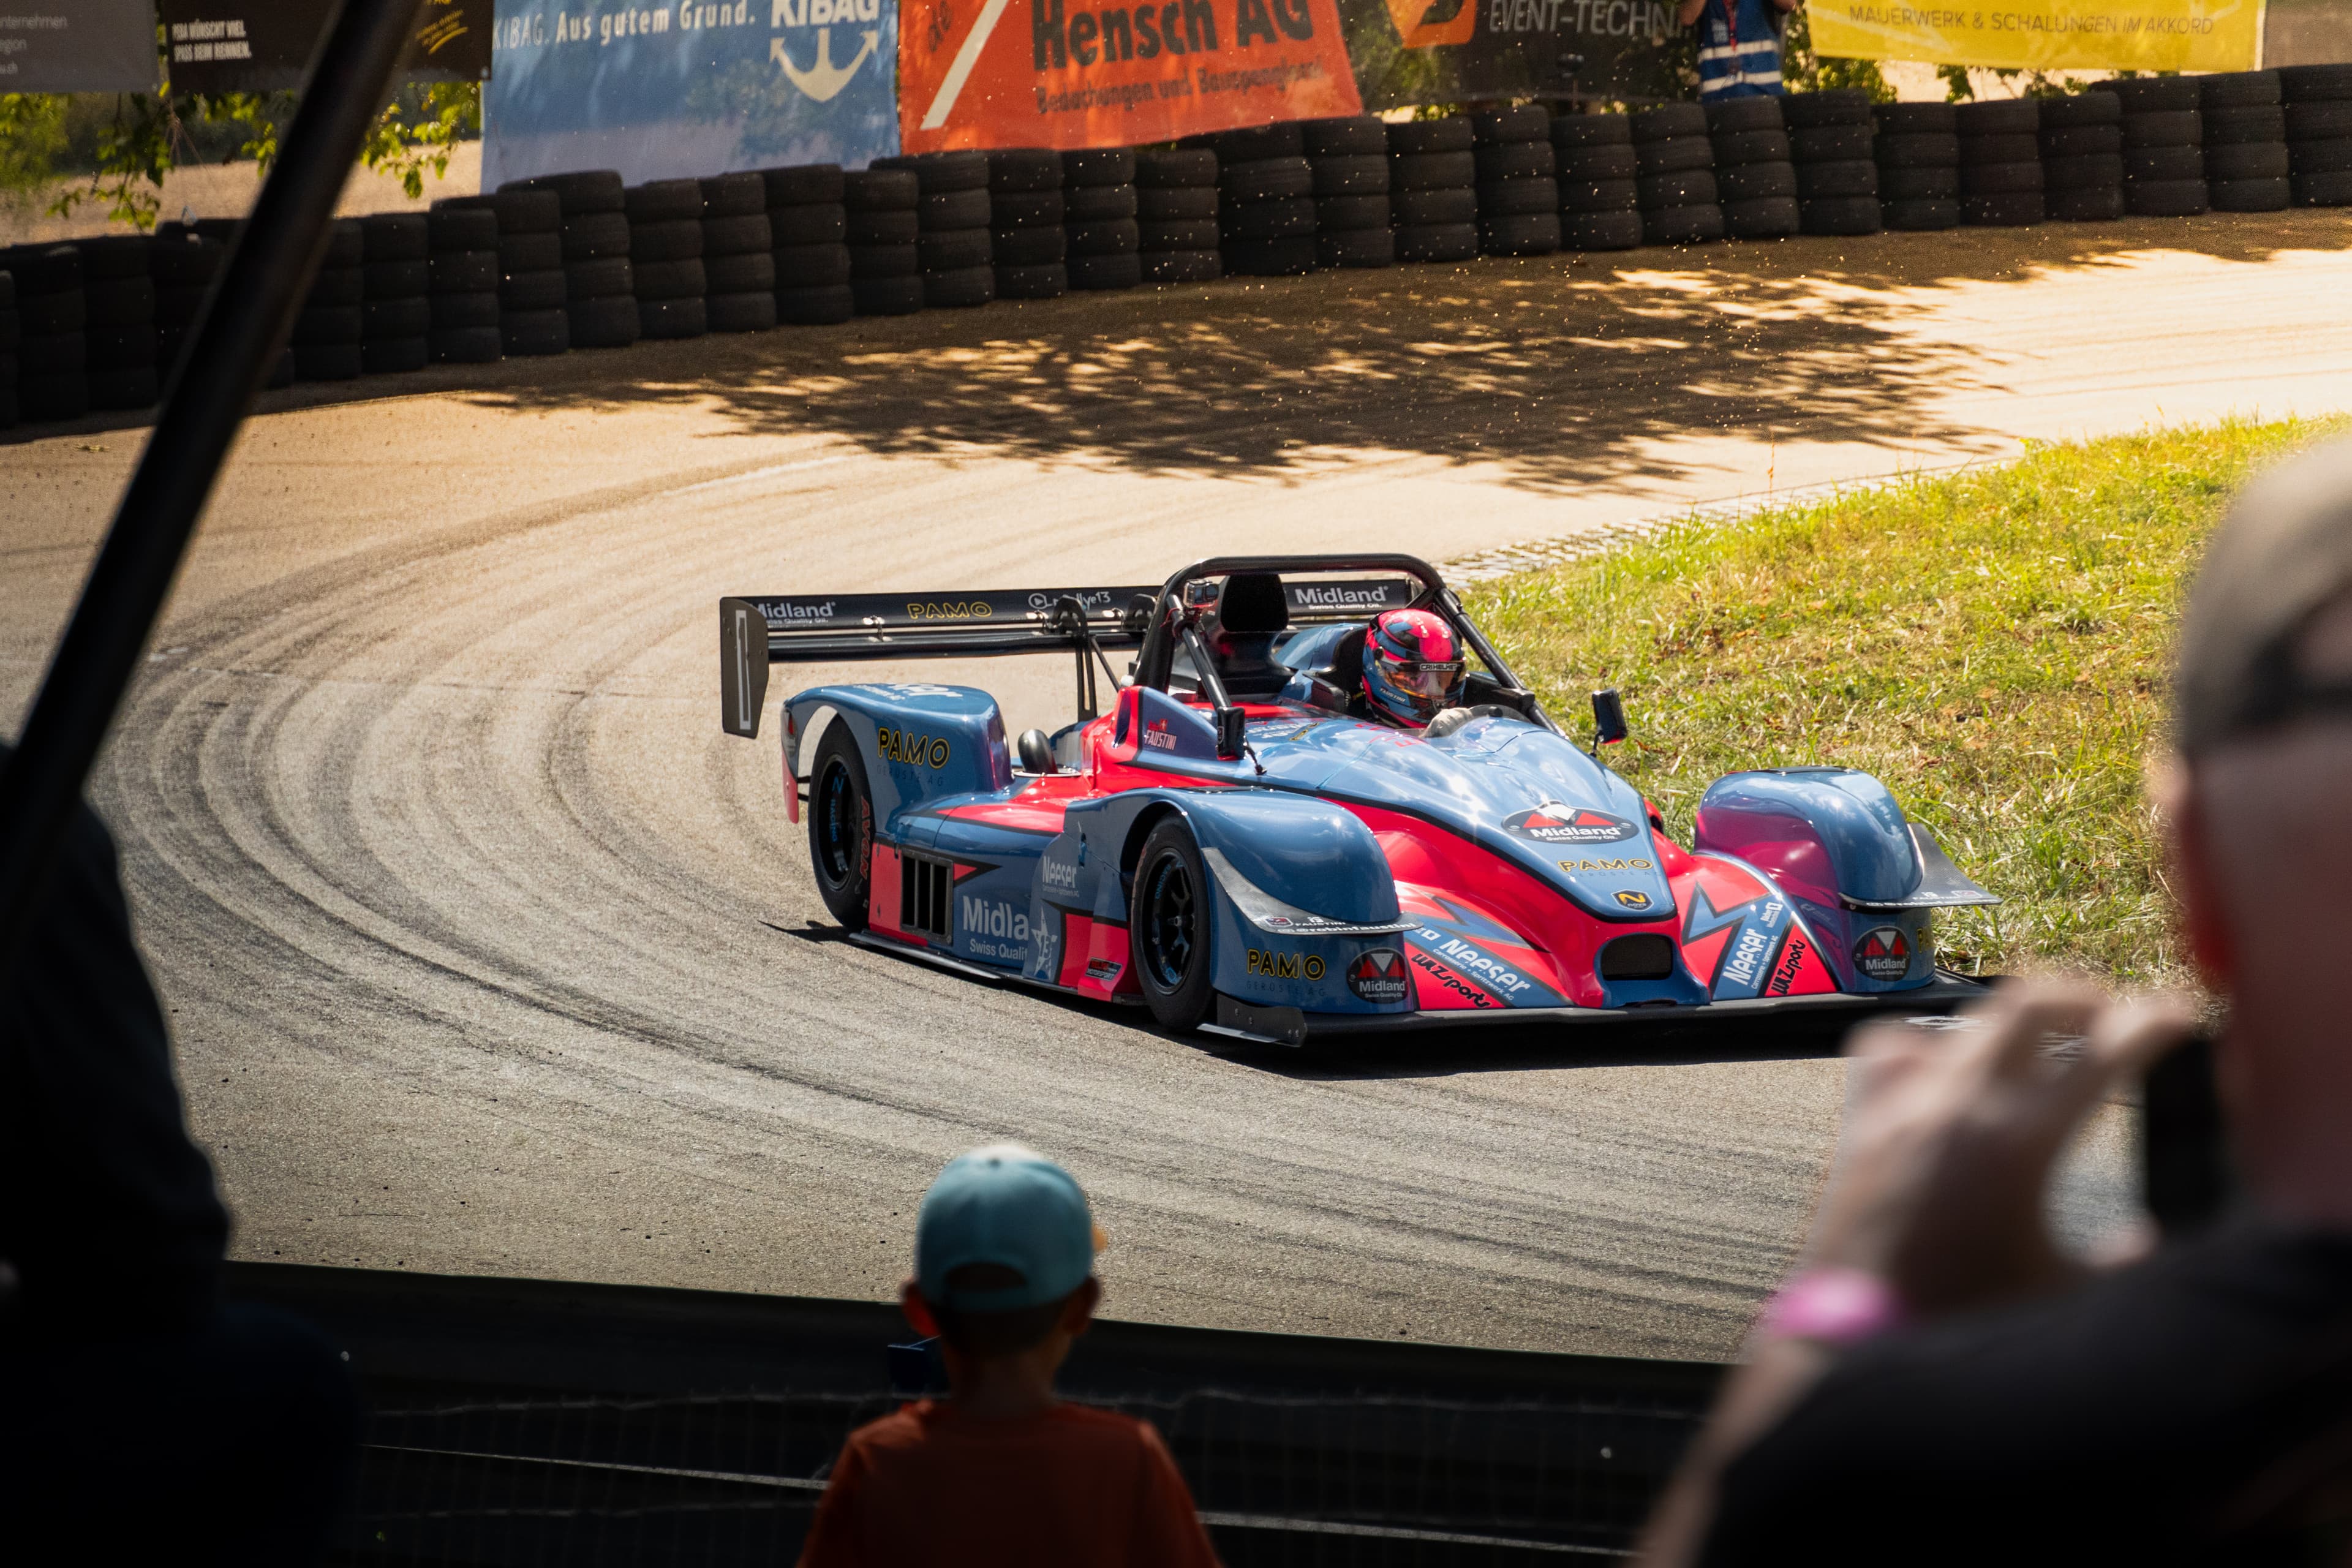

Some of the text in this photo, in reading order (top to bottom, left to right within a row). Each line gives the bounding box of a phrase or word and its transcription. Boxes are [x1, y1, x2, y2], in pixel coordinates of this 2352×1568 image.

[556, 11, 592, 43] Aus
[600, 7, 670, 47] gutem
[679, 0, 755, 30] Grund.
[1850, 6, 2214, 35] MAUERWERK & SCHALUNGEN IM AKKORD
[1031, 0, 1314, 71] Hensch AG
[907, 601, 992, 619] PAMO
[878, 727, 950, 769] PAMO
[1144, 729, 1177, 750] FAUSTINI
[830, 798, 839, 843] RACING
[861, 795, 871, 881] AVON
[1529, 827, 1621, 838] Midland
[1558, 858, 1654, 873] PAMO
[970, 938, 997, 956] Swiss
[1247, 949, 1325, 981] PAMO
[1865, 959, 1906, 970] Midland
[1359, 981, 1406, 992] Midland
[1503, 992, 1515, 1001] AG
